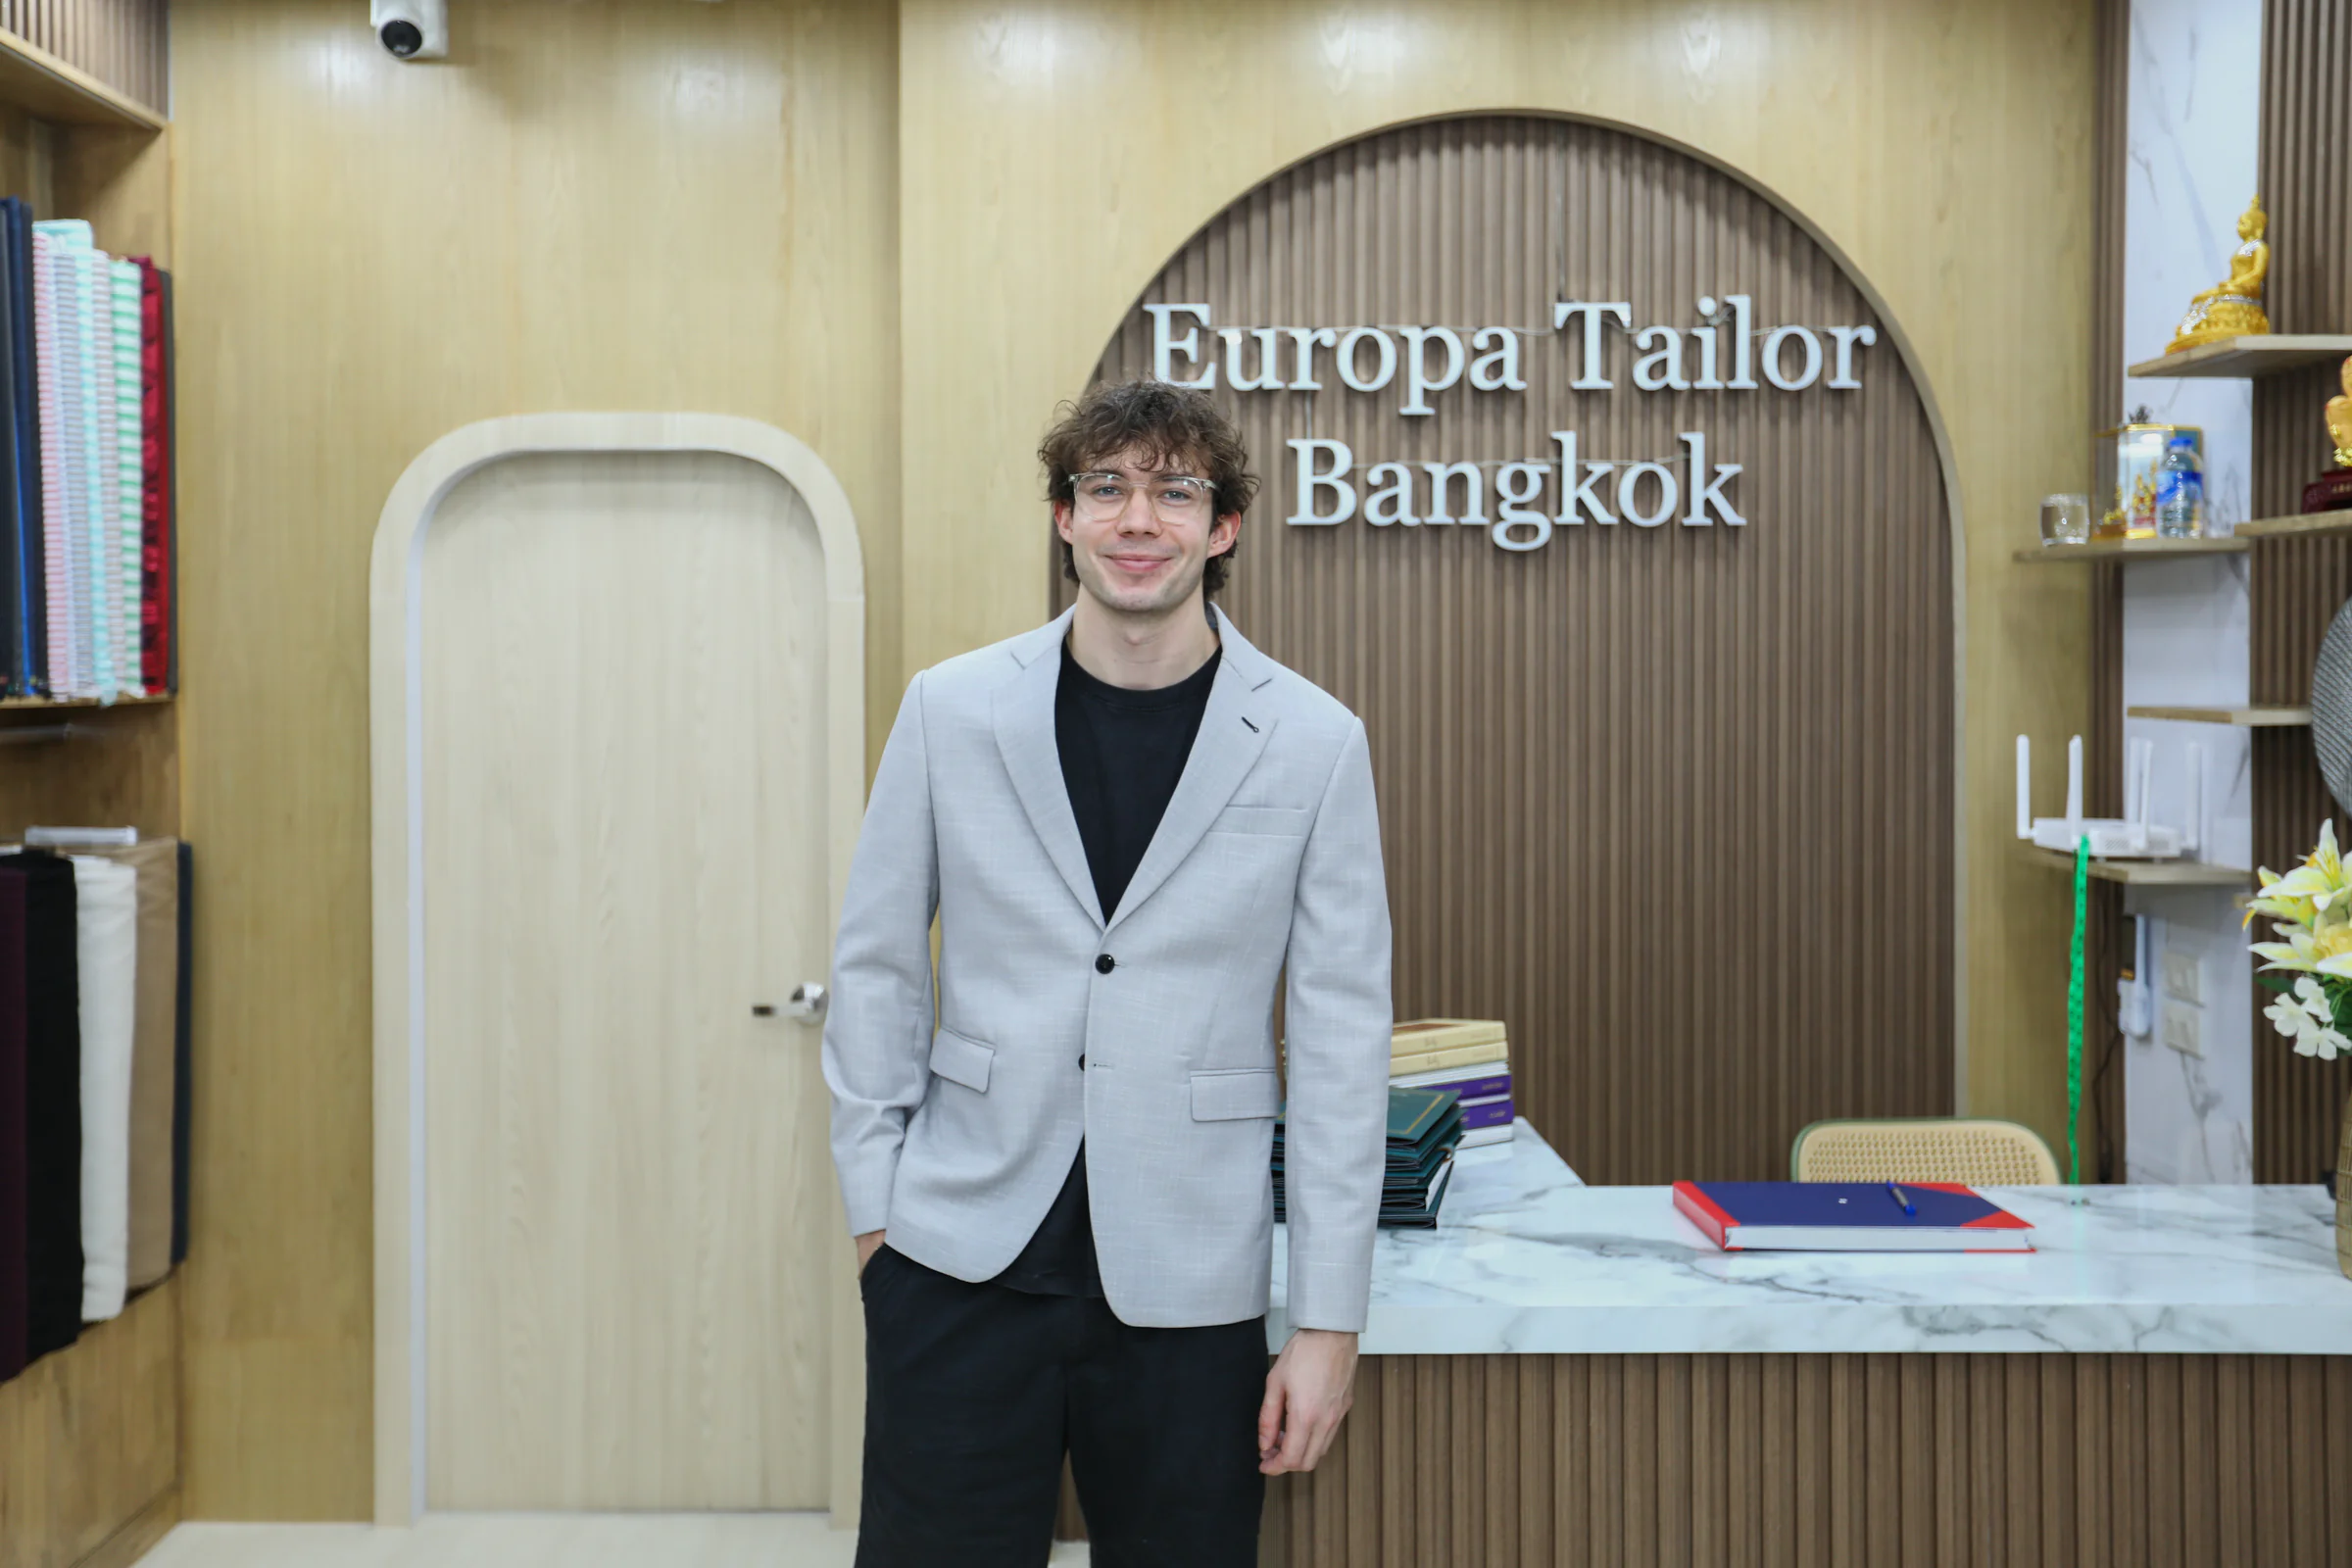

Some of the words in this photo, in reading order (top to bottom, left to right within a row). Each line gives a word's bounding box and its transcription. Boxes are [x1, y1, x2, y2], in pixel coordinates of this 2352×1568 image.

[1143, 303, 1526, 416] Europa
[1553, 295, 1877, 391] Tailor
[1286, 430, 1746, 551] Bangkok
